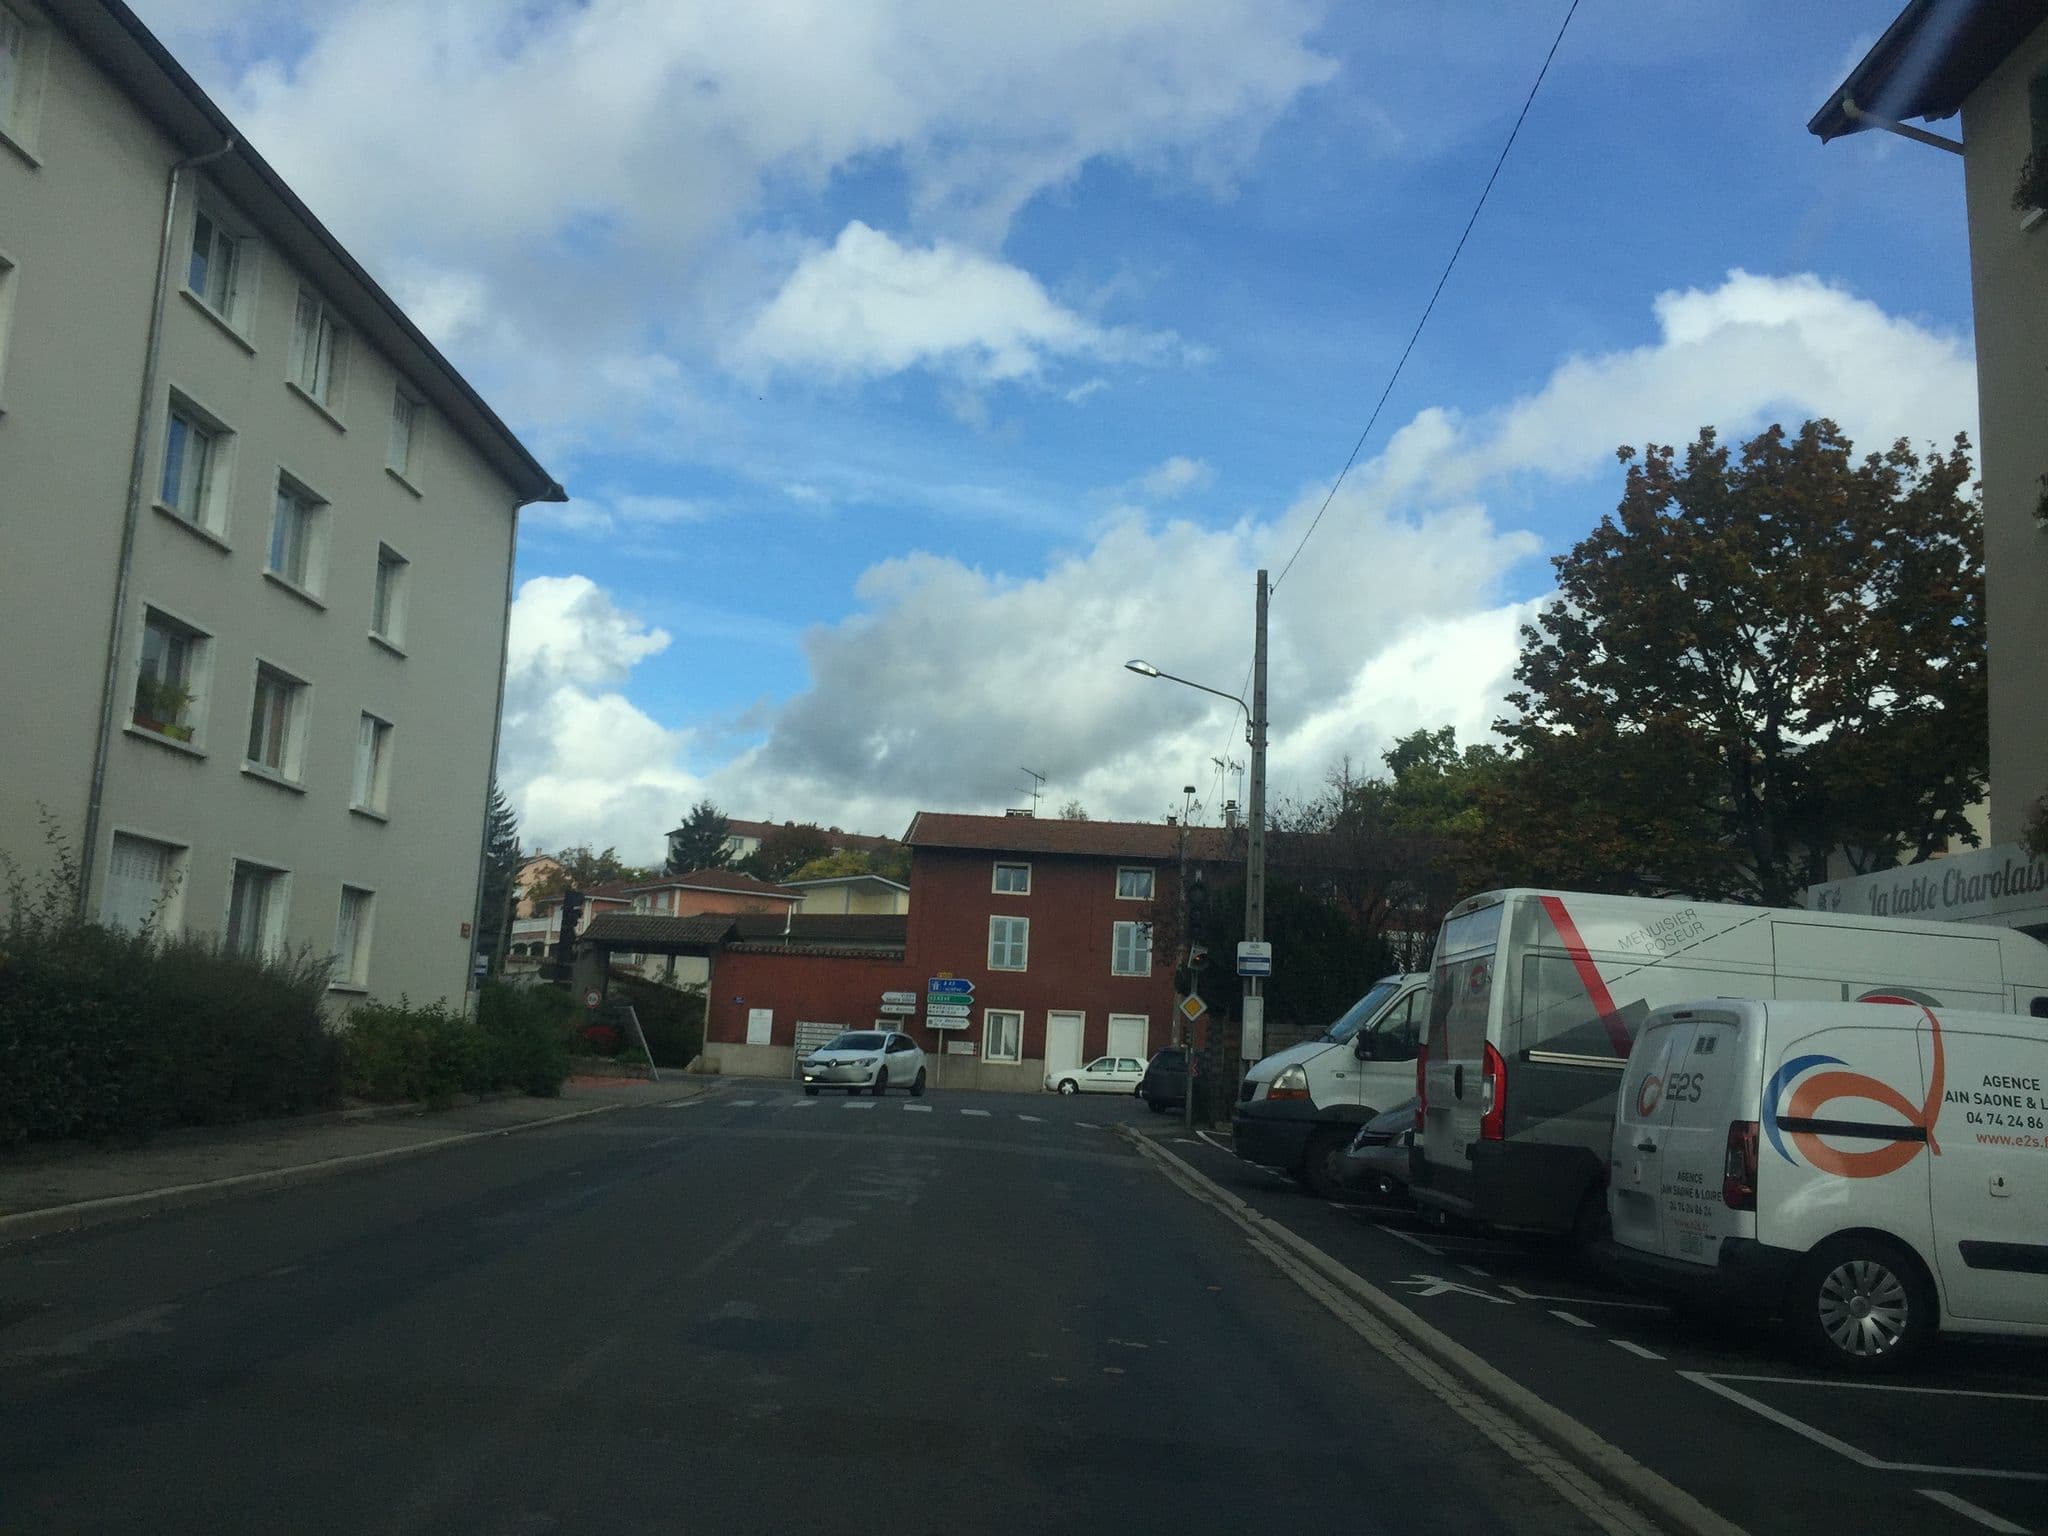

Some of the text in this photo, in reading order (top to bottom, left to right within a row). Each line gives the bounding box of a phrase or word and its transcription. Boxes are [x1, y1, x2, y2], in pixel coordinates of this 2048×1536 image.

[1892, 876, 1936, 915] table
[1618, 908, 1697, 949] MENUISIER
[1645, 921, 1705, 955] POSEUR
[1666, 1073, 1704, 1103] E2S
[1983, 1075, 2040, 1091] AGENCE
[1945, 1090, 1970, 1104] AIN
[1973, 1093, 2022, 1108] SAONE
[2026, 1097, 2037, 1110] &
[1966, 1112, 2044, 1129] 04 74 24 86
[1677, 1171, 1704, 1184] AGENCE
[1701, 1189, 1722, 1202] LOIRE
